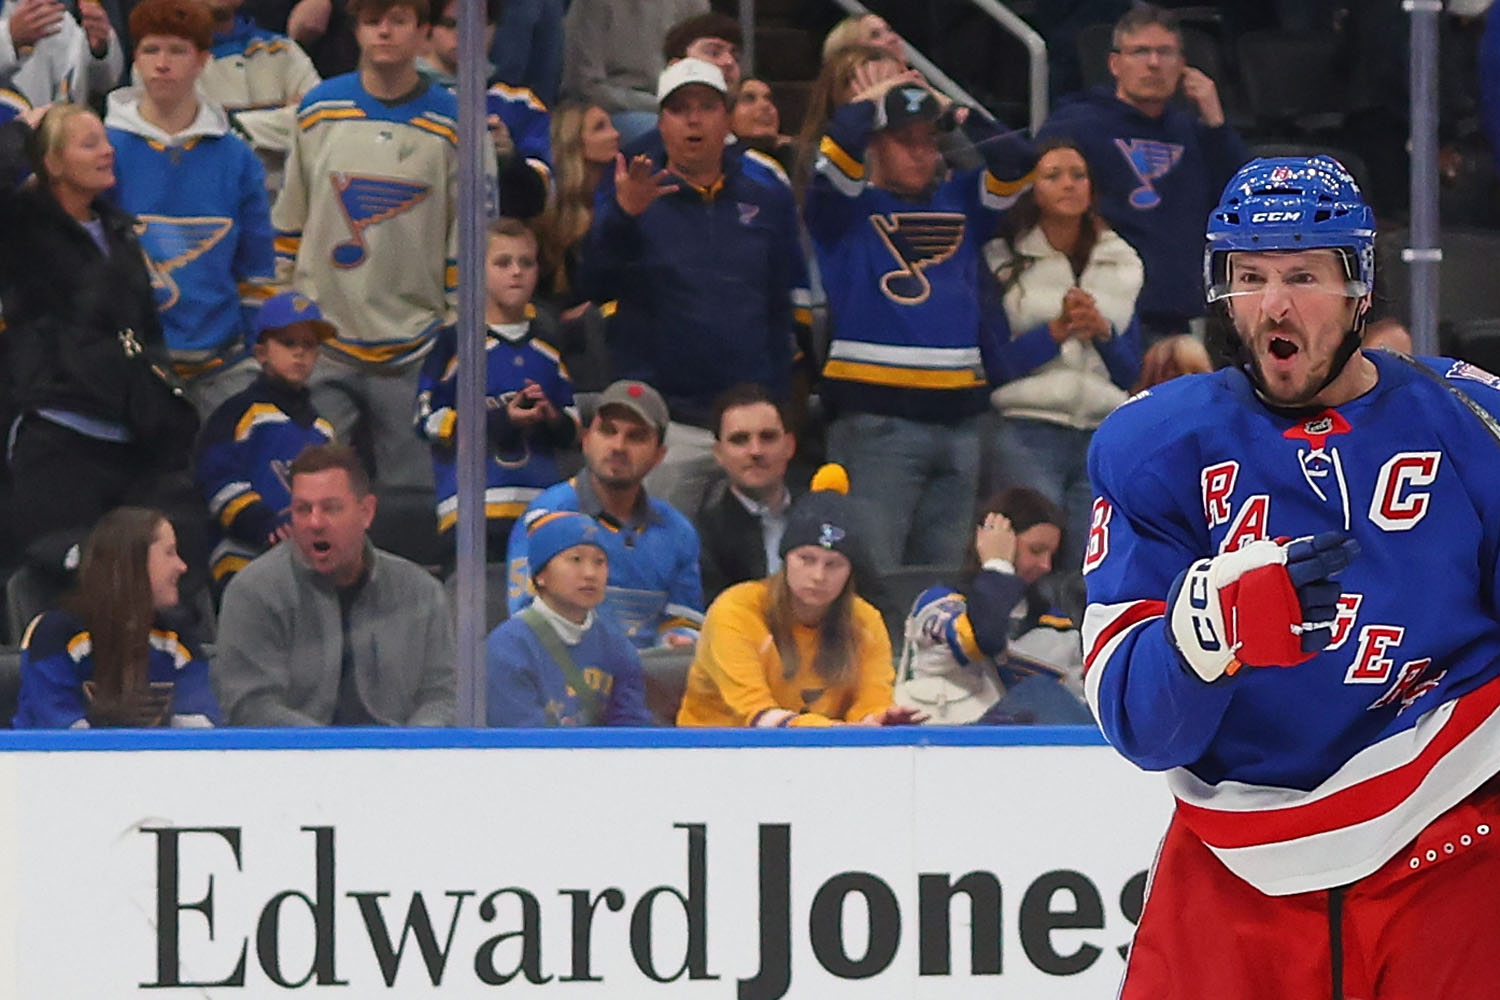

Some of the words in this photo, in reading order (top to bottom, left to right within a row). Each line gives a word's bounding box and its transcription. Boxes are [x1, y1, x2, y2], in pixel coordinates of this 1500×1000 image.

[1252, 211, 1301, 223] CCM
[1368, 451, 1443, 532] C
[1190, 557, 1222, 652] CC
[1200, 460, 1447, 717] RAER
[138, 822, 721, 989] Edward
